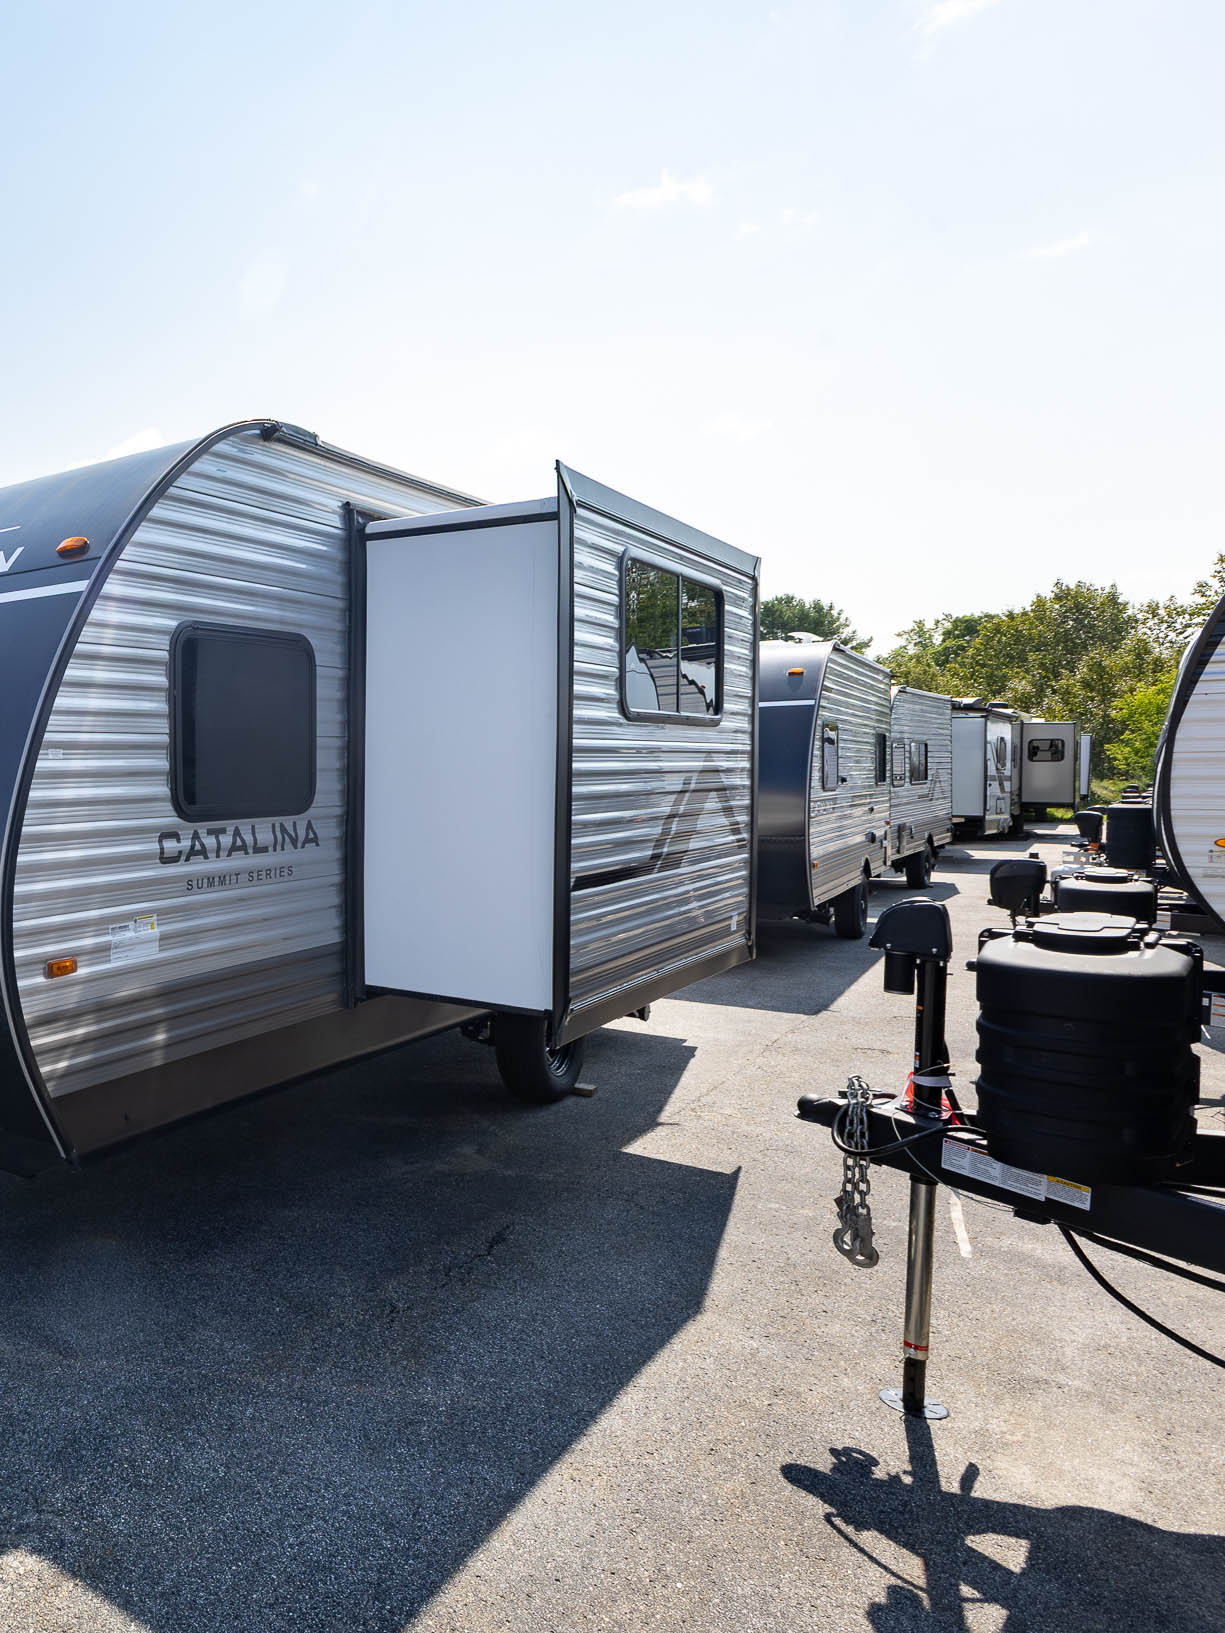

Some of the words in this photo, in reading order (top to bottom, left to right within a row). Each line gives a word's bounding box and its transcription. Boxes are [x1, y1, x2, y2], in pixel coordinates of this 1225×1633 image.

[158, 819, 320, 864] CATALINA
[186, 872, 241, 891] SUMMIT
[247, 865, 294, 882] SERIES
